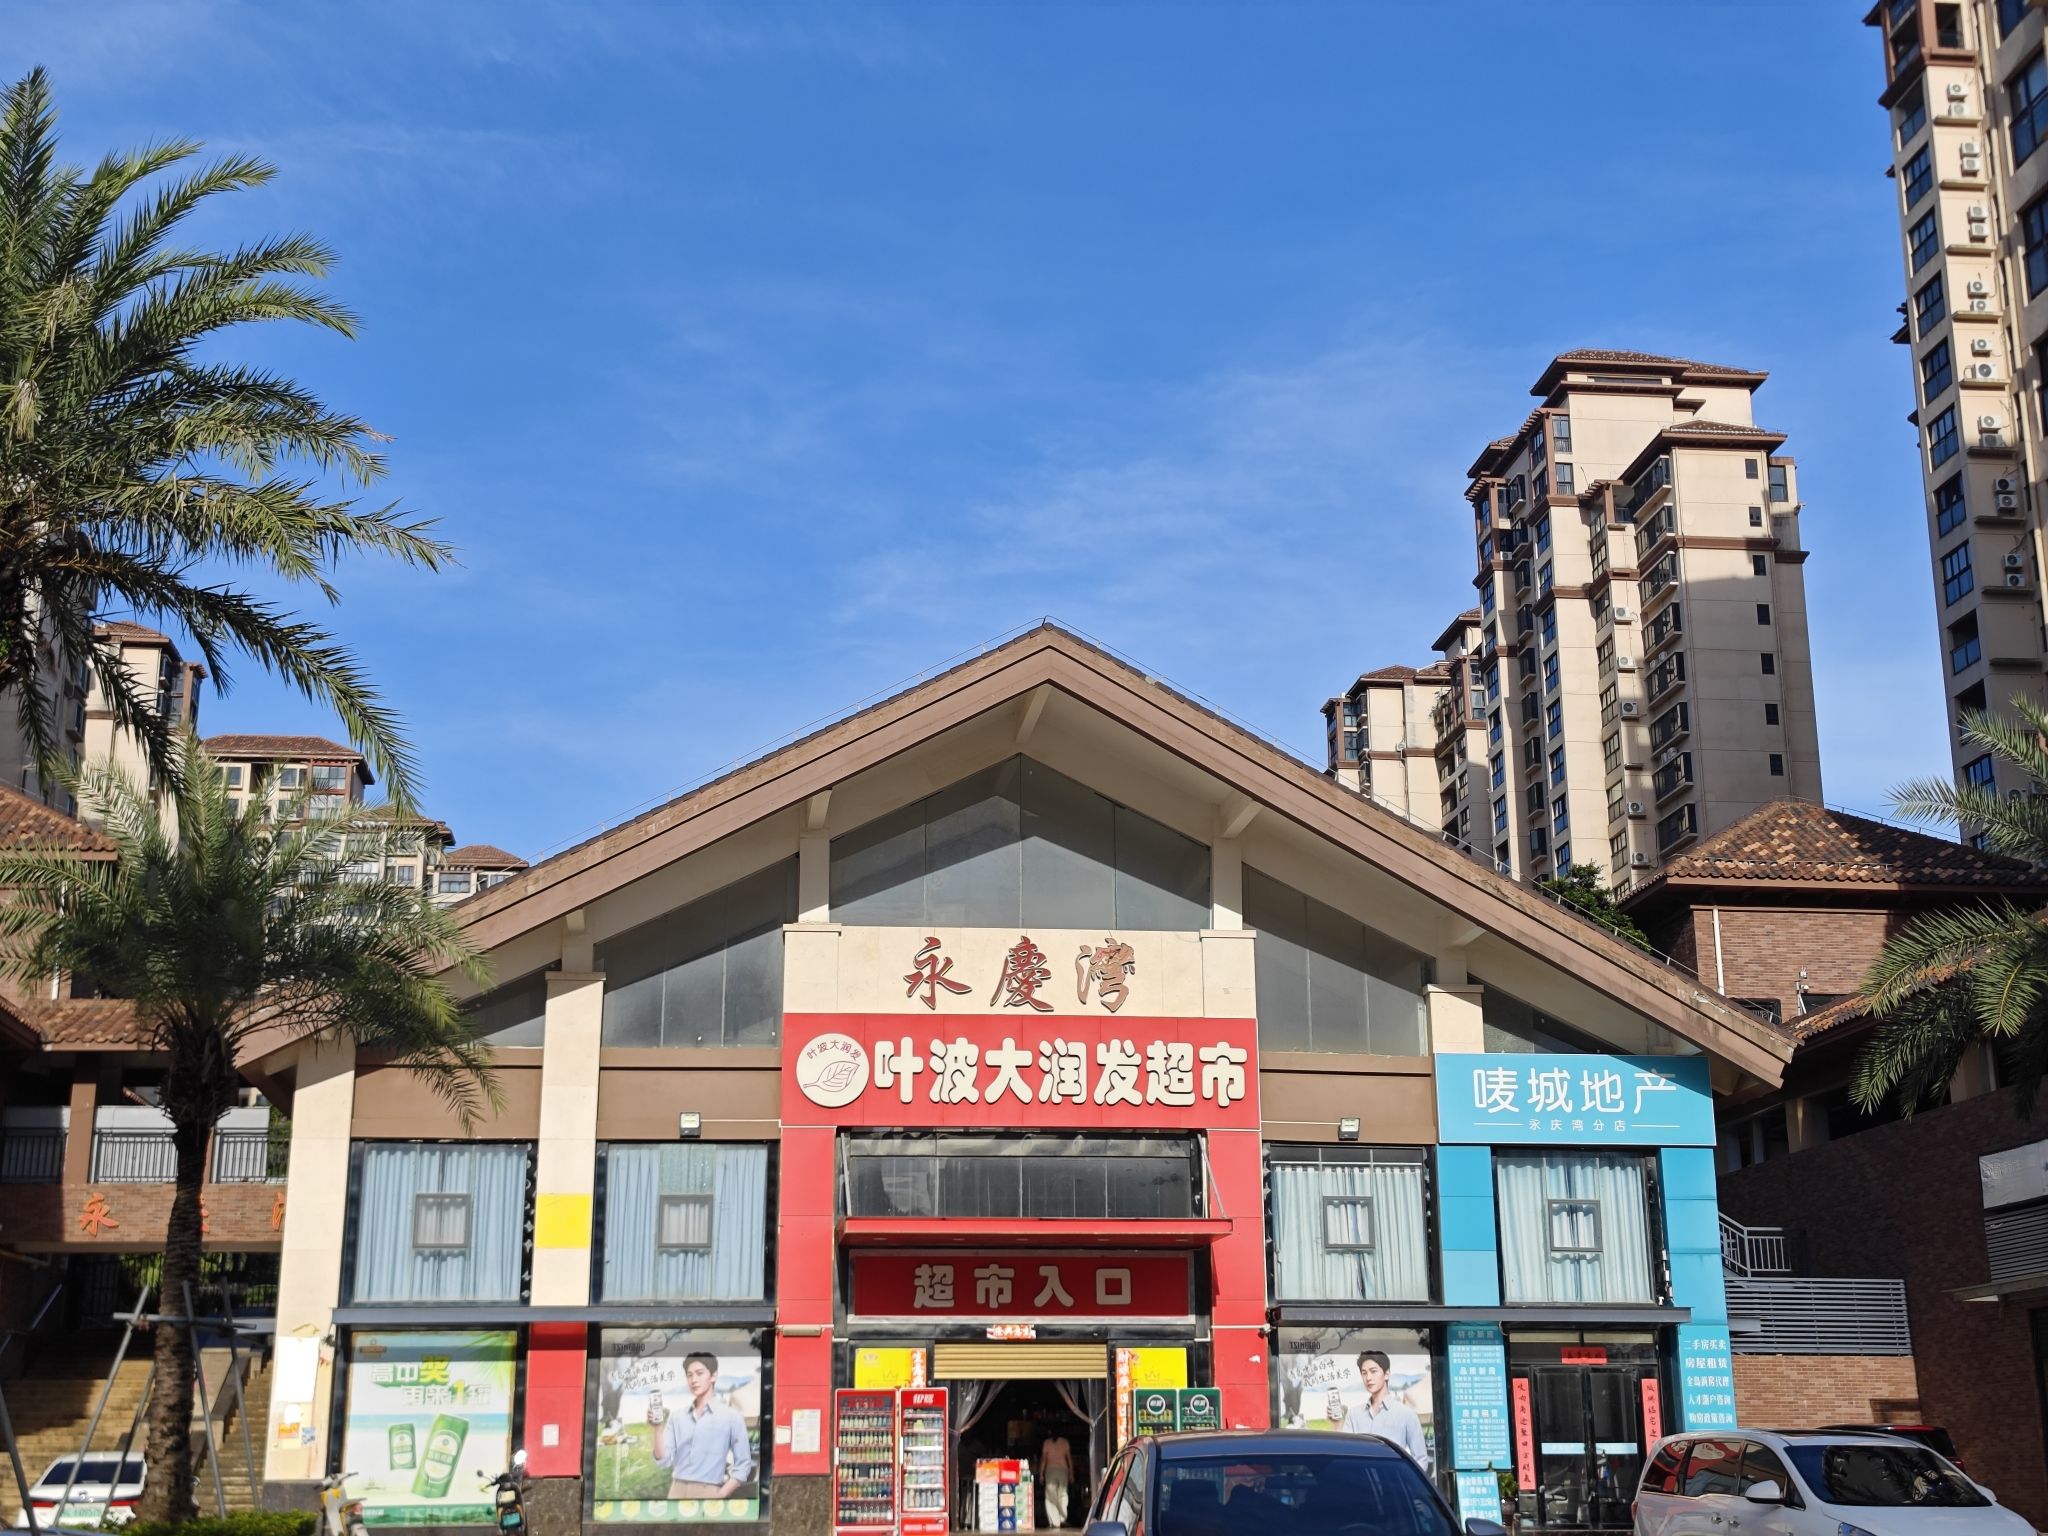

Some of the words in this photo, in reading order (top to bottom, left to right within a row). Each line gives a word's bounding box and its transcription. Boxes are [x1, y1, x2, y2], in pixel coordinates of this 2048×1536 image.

[806, 1039, 862, 1061] 叶波大润发
[873, 1036, 1248, 1107] 叶波大润发超市
[1472, 1066, 1678, 1115] 唛城地产
[1528, 1118, 1626, 1132] 永庆湾分店
[913, 1263, 1133, 1309] 超市入口
[1683, 1338, 1727, 1351] 二手房买卖
[1685, 1357, 1728, 1369] 房屋租赁
